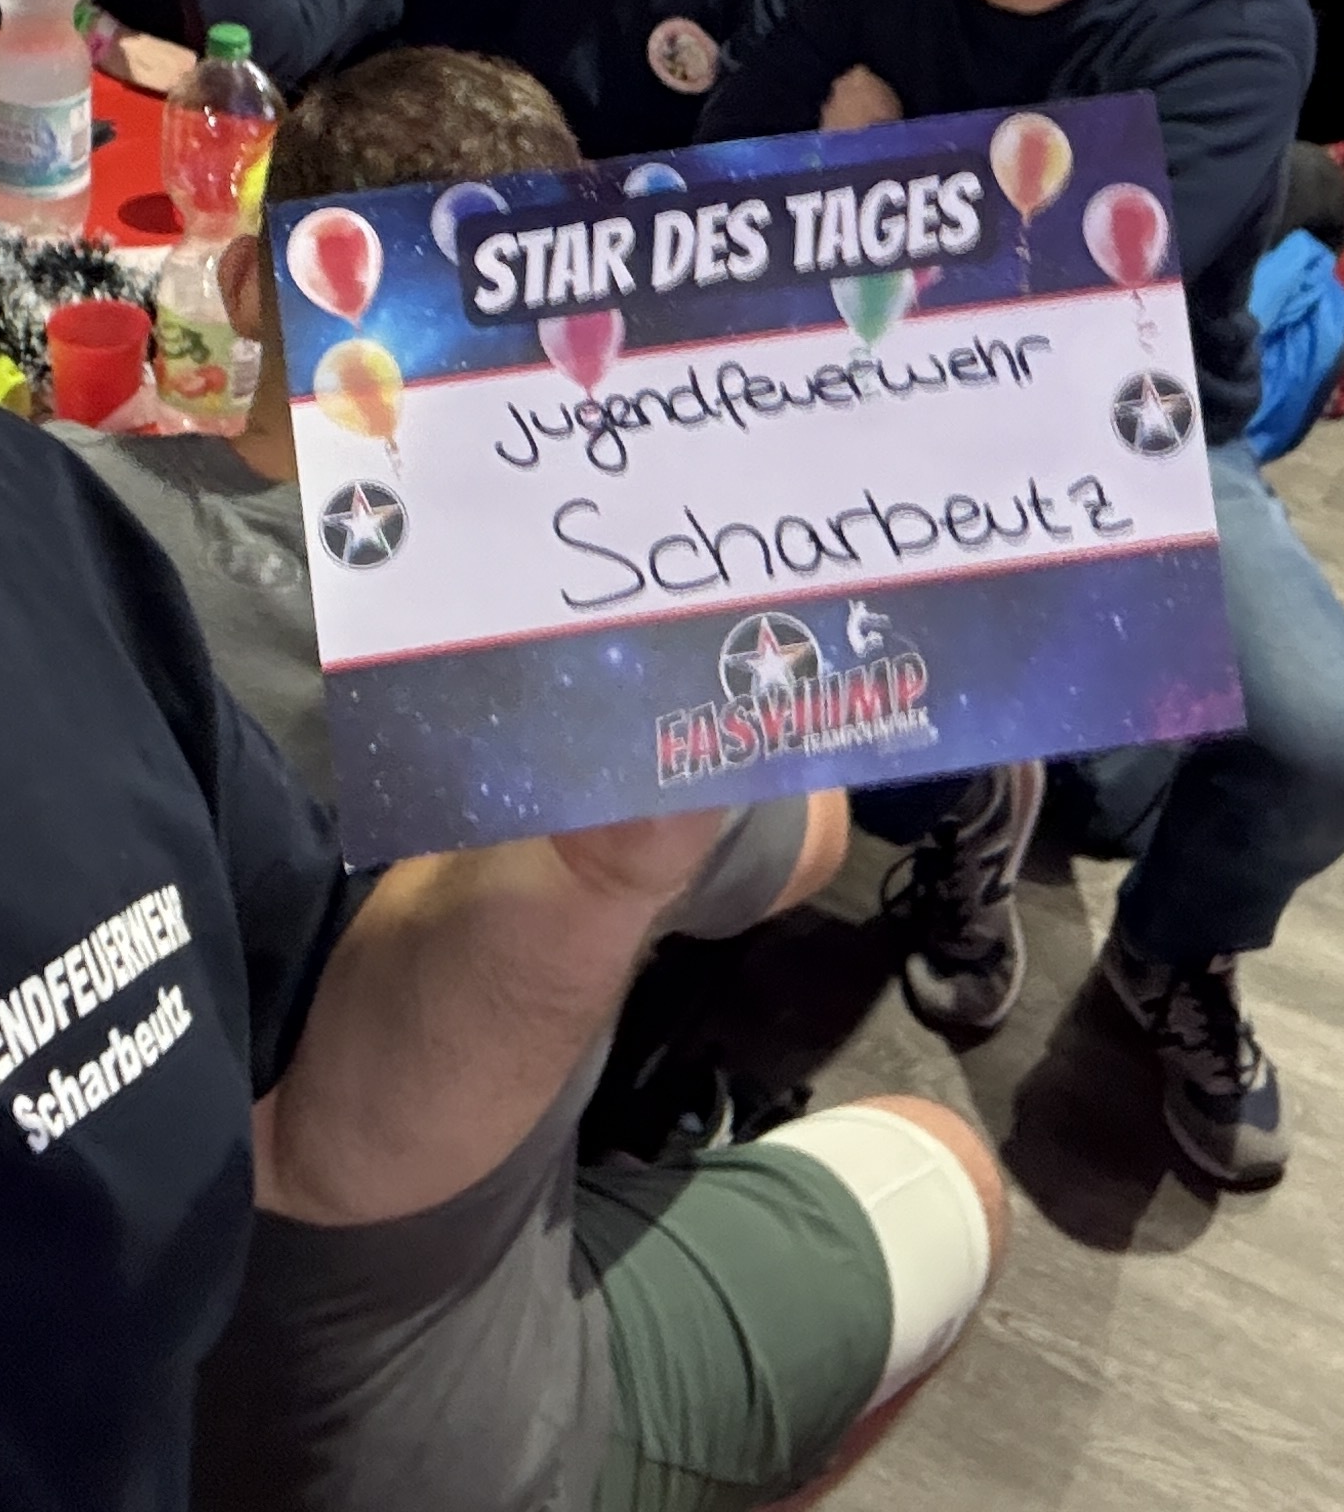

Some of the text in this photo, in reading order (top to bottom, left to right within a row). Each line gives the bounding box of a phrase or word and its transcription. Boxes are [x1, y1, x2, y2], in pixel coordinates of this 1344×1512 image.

[472, 171, 985, 315] STAR DES TAGES
[551, 474, 1134, 610] Scharbeutz
[11, 984, 194, 1155] Scharbeutz
